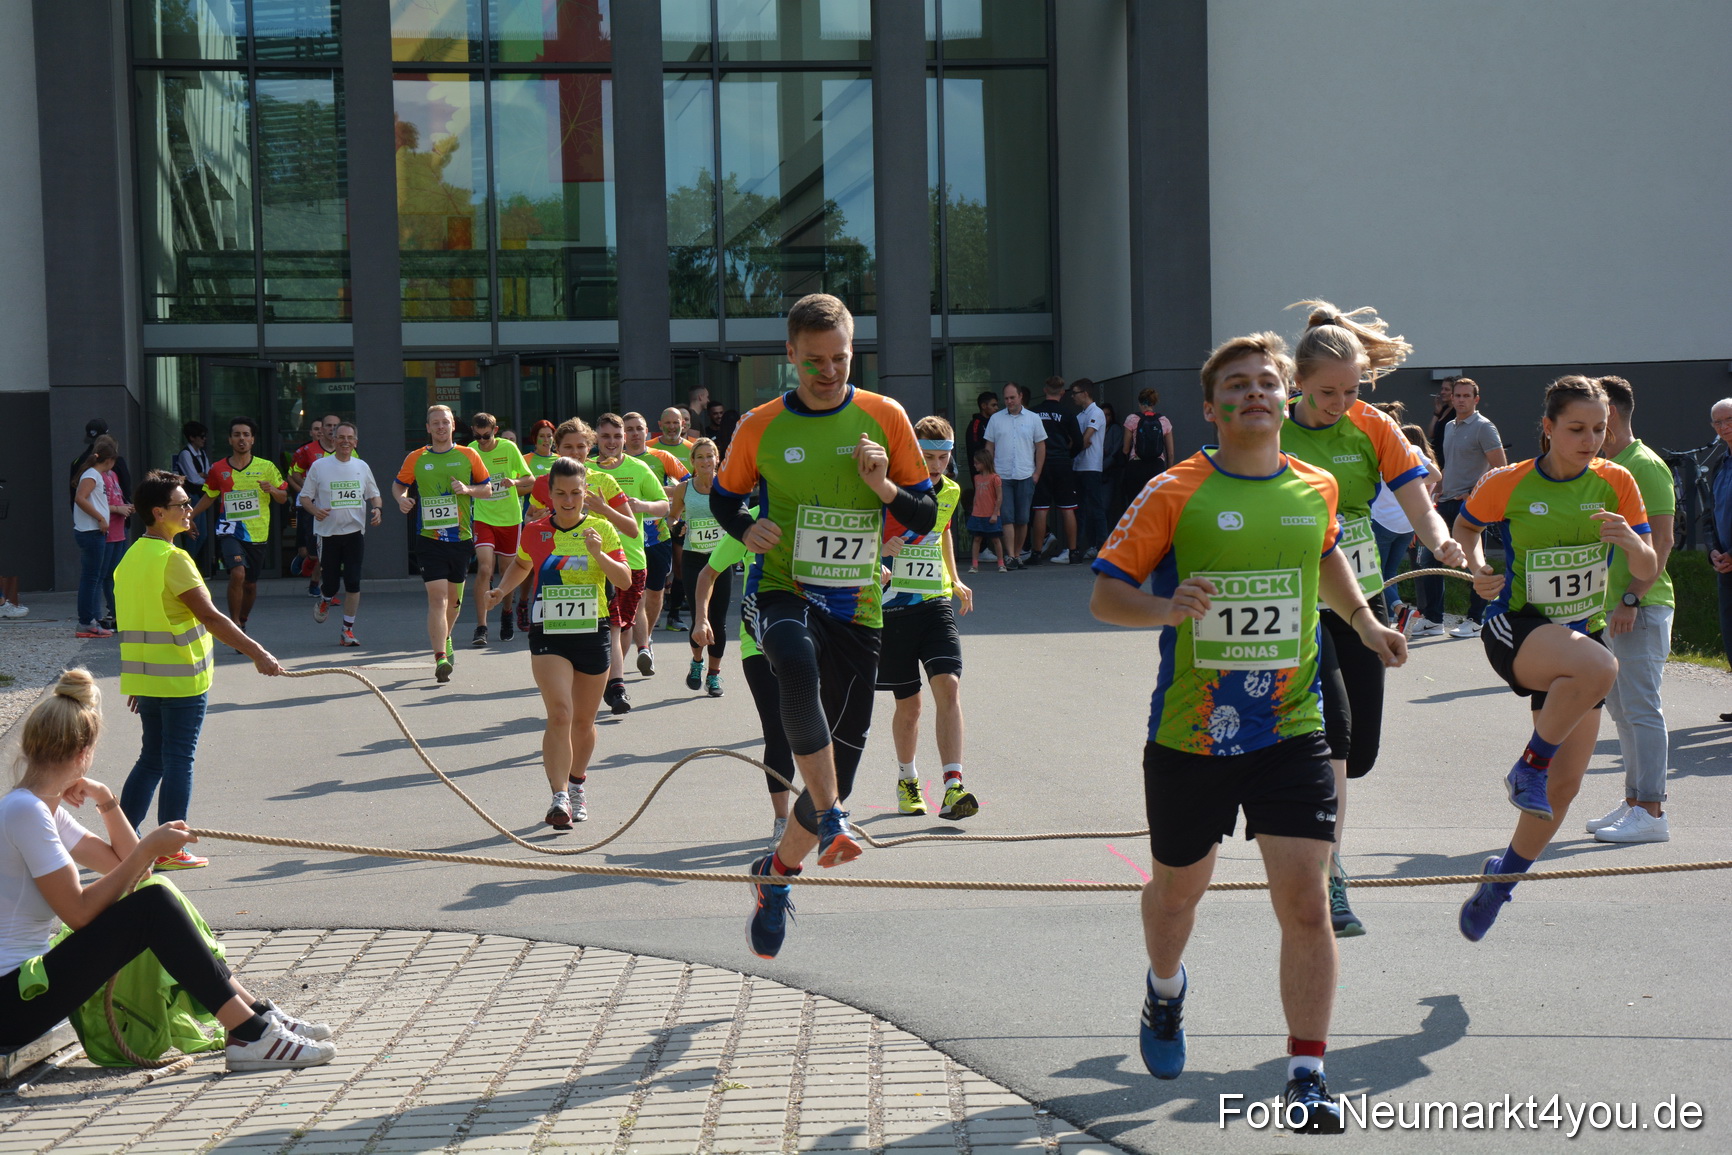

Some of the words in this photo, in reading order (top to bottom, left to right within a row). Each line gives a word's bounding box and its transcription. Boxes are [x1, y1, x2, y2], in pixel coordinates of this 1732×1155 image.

[436, 387, 460, 395] REWE
[1332, 454, 1363, 464] BOCK
[226, 491, 257, 501] BOCK
[338, 490, 357, 499] 146
[423, 496, 454, 506] BOCK
[231, 500, 253, 511] 168
[1581, 502, 1606, 511] BOCK
[429, 507, 451, 518] 192
[804, 509, 875, 531] BOCK
[1281, 516, 1317, 526] BOCK
[697, 529, 719, 541] 145
[816, 536, 864, 560] 127
[898, 546, 941, 559] BOCK
[1533, 544, 1604, 570] BOCK
[811, 565, 861, 578] MARTIN
[906, 562, 934, 578] 172
[1207, 573, 1294, 598] BOCK
[1548, 570, 1593, 598] 131
[546, 586, 594, 598] BOCK
[555, 602, 586, 617] 171
[1544, 598, 1594, 616] DANIELA
[1218, 606, 1281, 636] 122
[1221, 644, 1279, 659] JONAS
